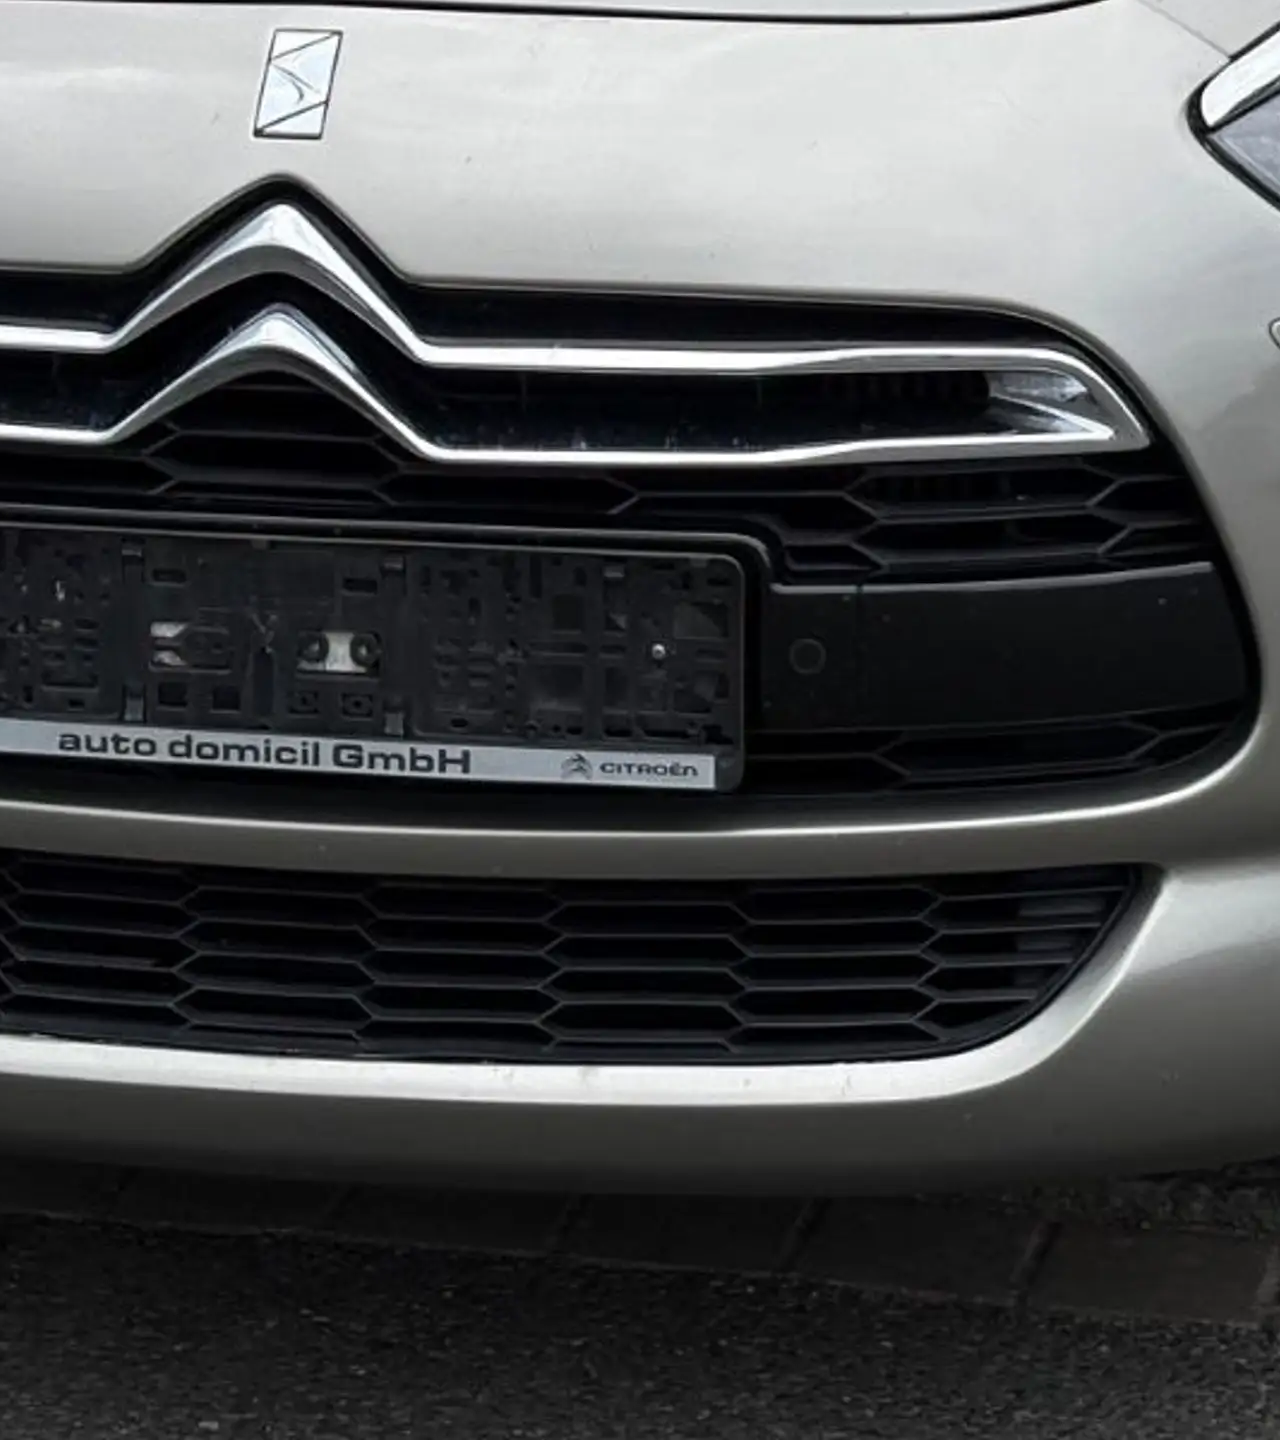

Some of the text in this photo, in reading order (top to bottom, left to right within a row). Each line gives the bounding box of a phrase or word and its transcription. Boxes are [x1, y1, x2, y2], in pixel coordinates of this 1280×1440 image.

[58, 731, 472, 775] auto domicil GmbH
